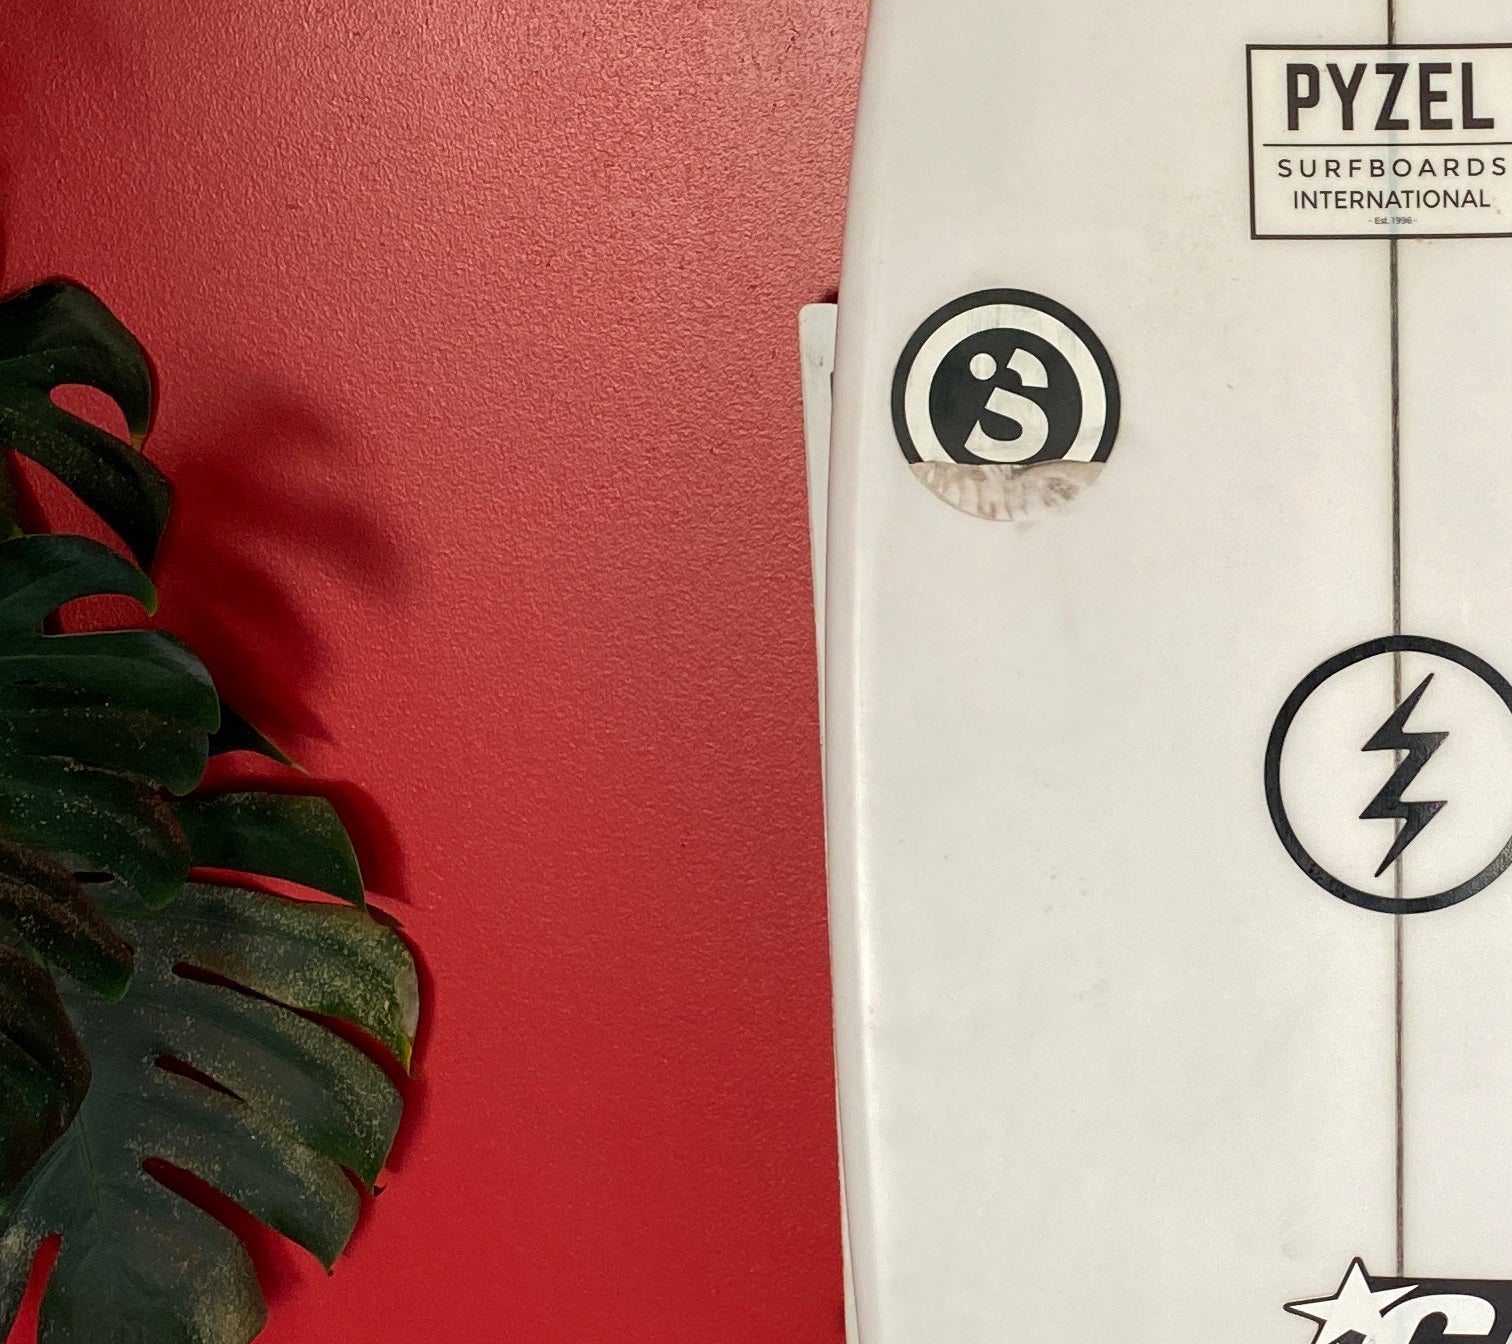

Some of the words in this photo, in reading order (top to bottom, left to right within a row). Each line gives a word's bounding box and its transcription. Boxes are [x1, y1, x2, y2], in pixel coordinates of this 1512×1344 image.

[1286, 62, 1495, 131] PYZEL
[1277, 157, 1507, 178] SURFBOARDS
[1293, 189, 1492, 210] INTERNATIONAL
